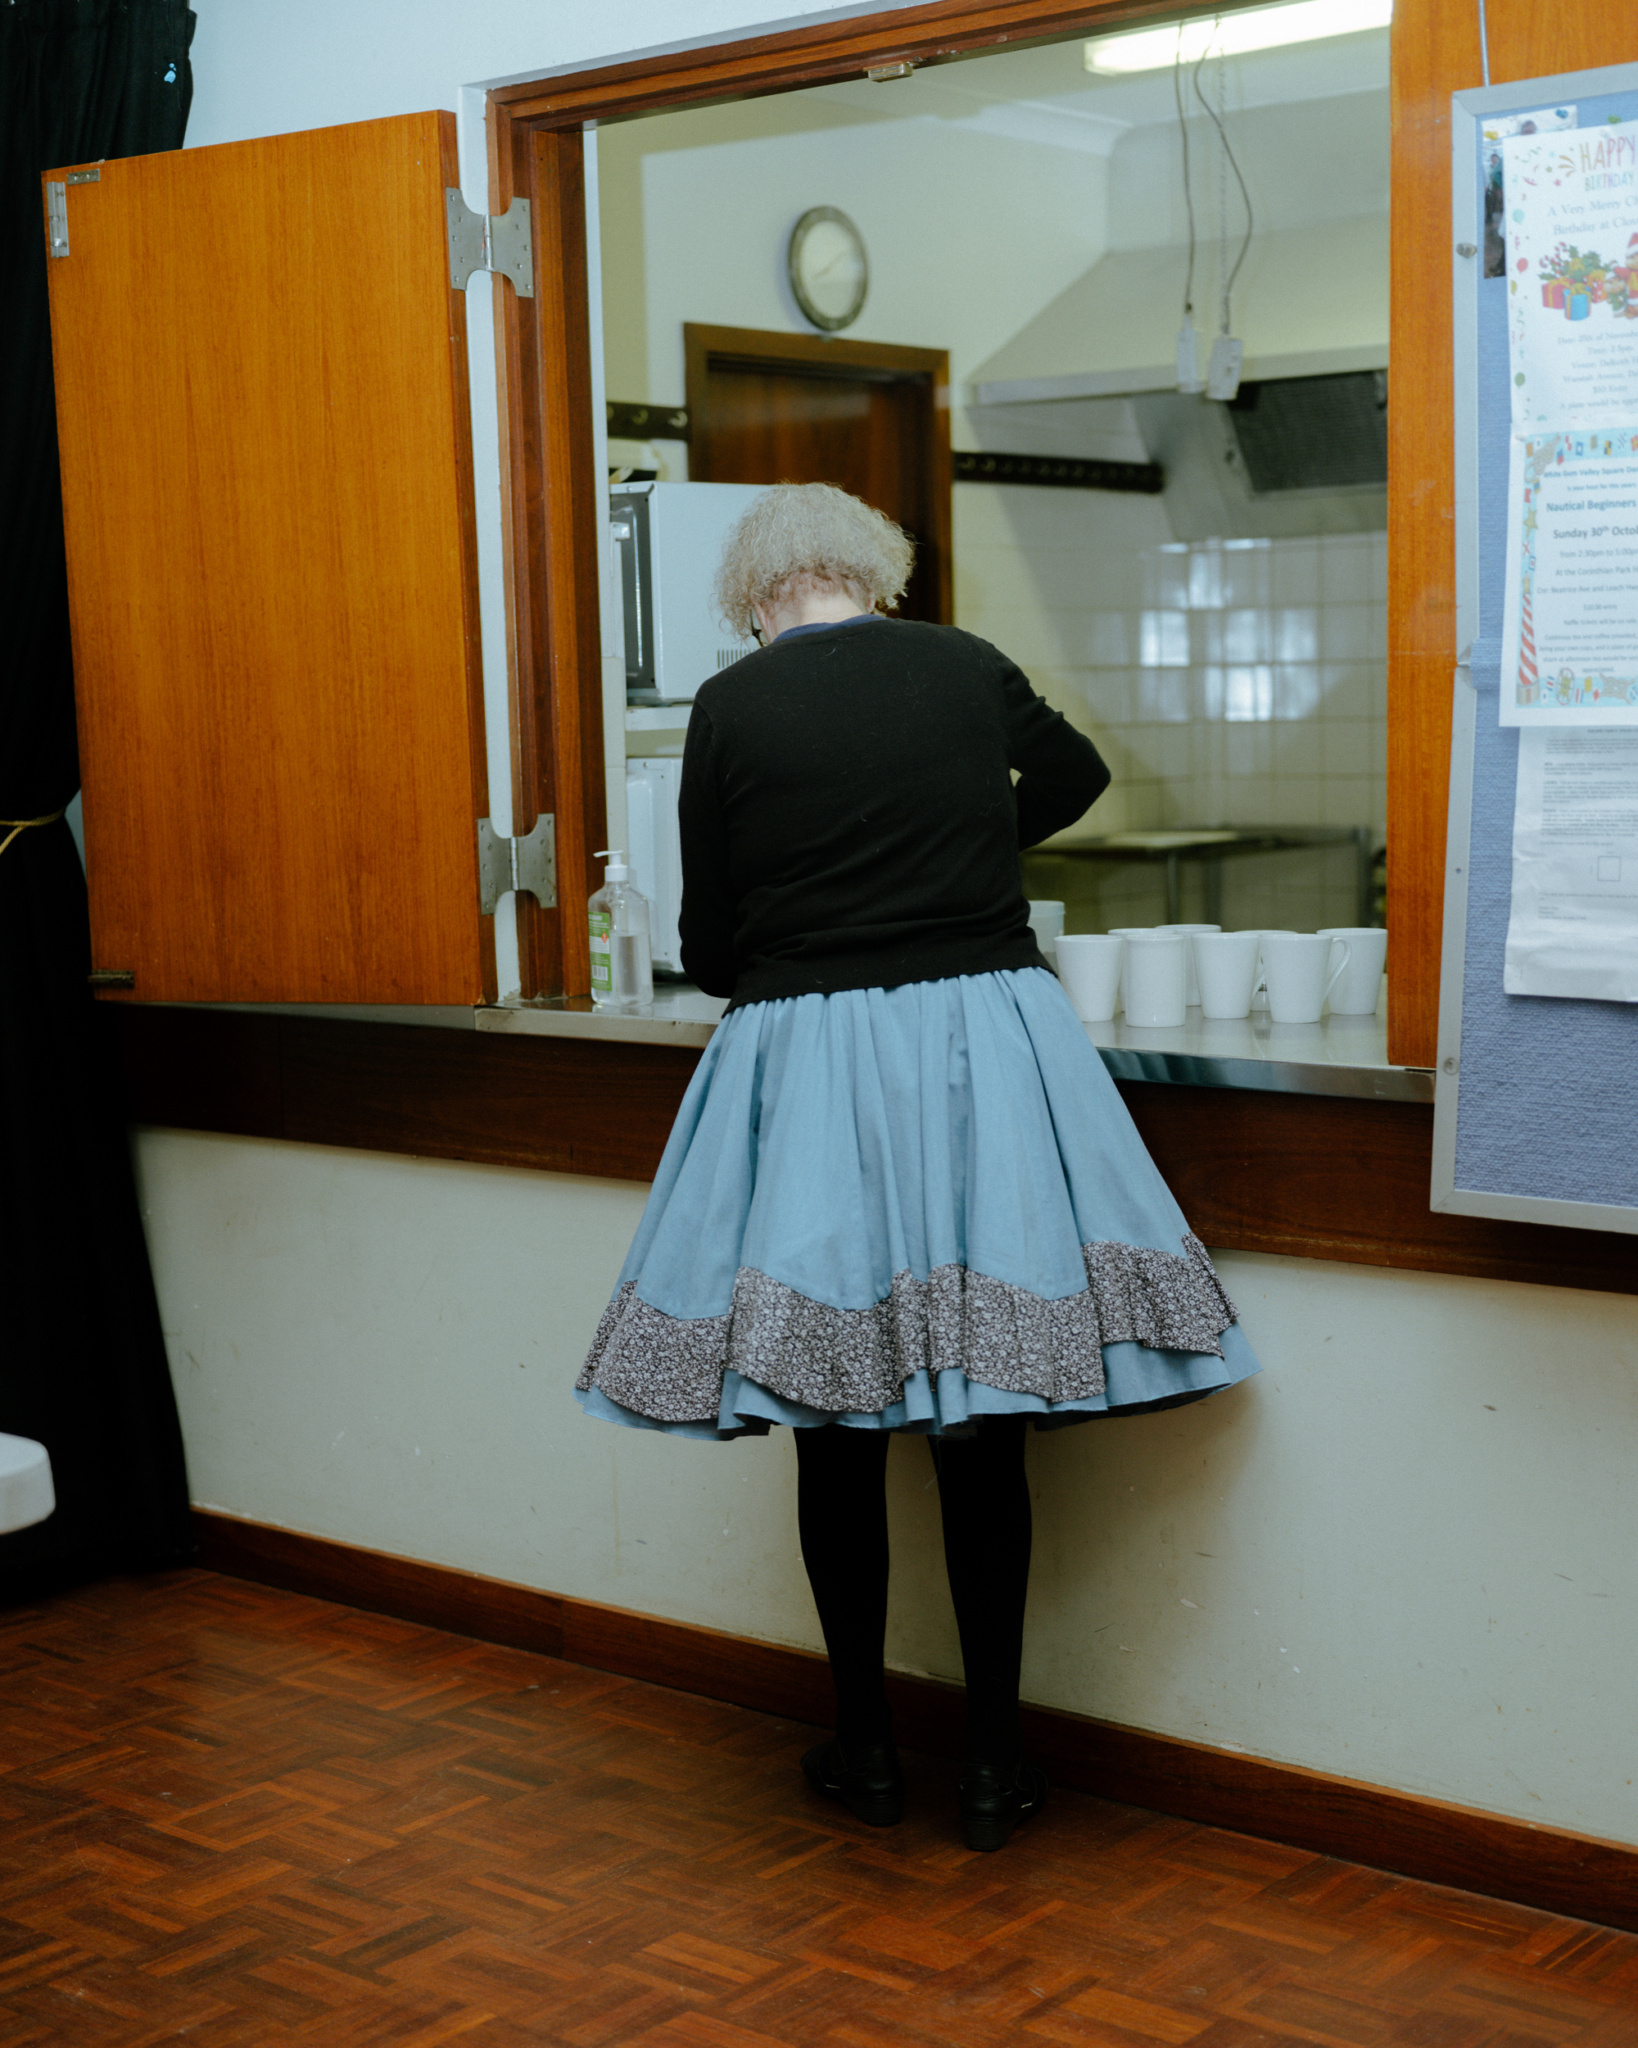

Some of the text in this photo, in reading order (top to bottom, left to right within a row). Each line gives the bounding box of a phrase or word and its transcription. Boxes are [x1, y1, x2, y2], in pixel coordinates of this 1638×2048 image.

[1579, 134, 1635, 173] HAPPY
[1585, 172, 1634, 191] BIRTHDAY
[1547, 207, 1557, 217] A
[1561, 203, 1584, 215] Very
[1589, 200, 1620, 213] Merry
[1553, 223, 1595, 235] Birthday
[1600, 220, 1610, 231] at
[1580, 468, 1600, 476] Valley
[1601, 467, 1624, 476] Square
[1546, 499, 1637, 512] Nautical Beginners
[1553, 527, 1588, 540] Sunday
[1564, 568, 1576, 576] the
[1577, 566, 1614, 576] Corinthian
[1615, 565, 1631, 573] Park
